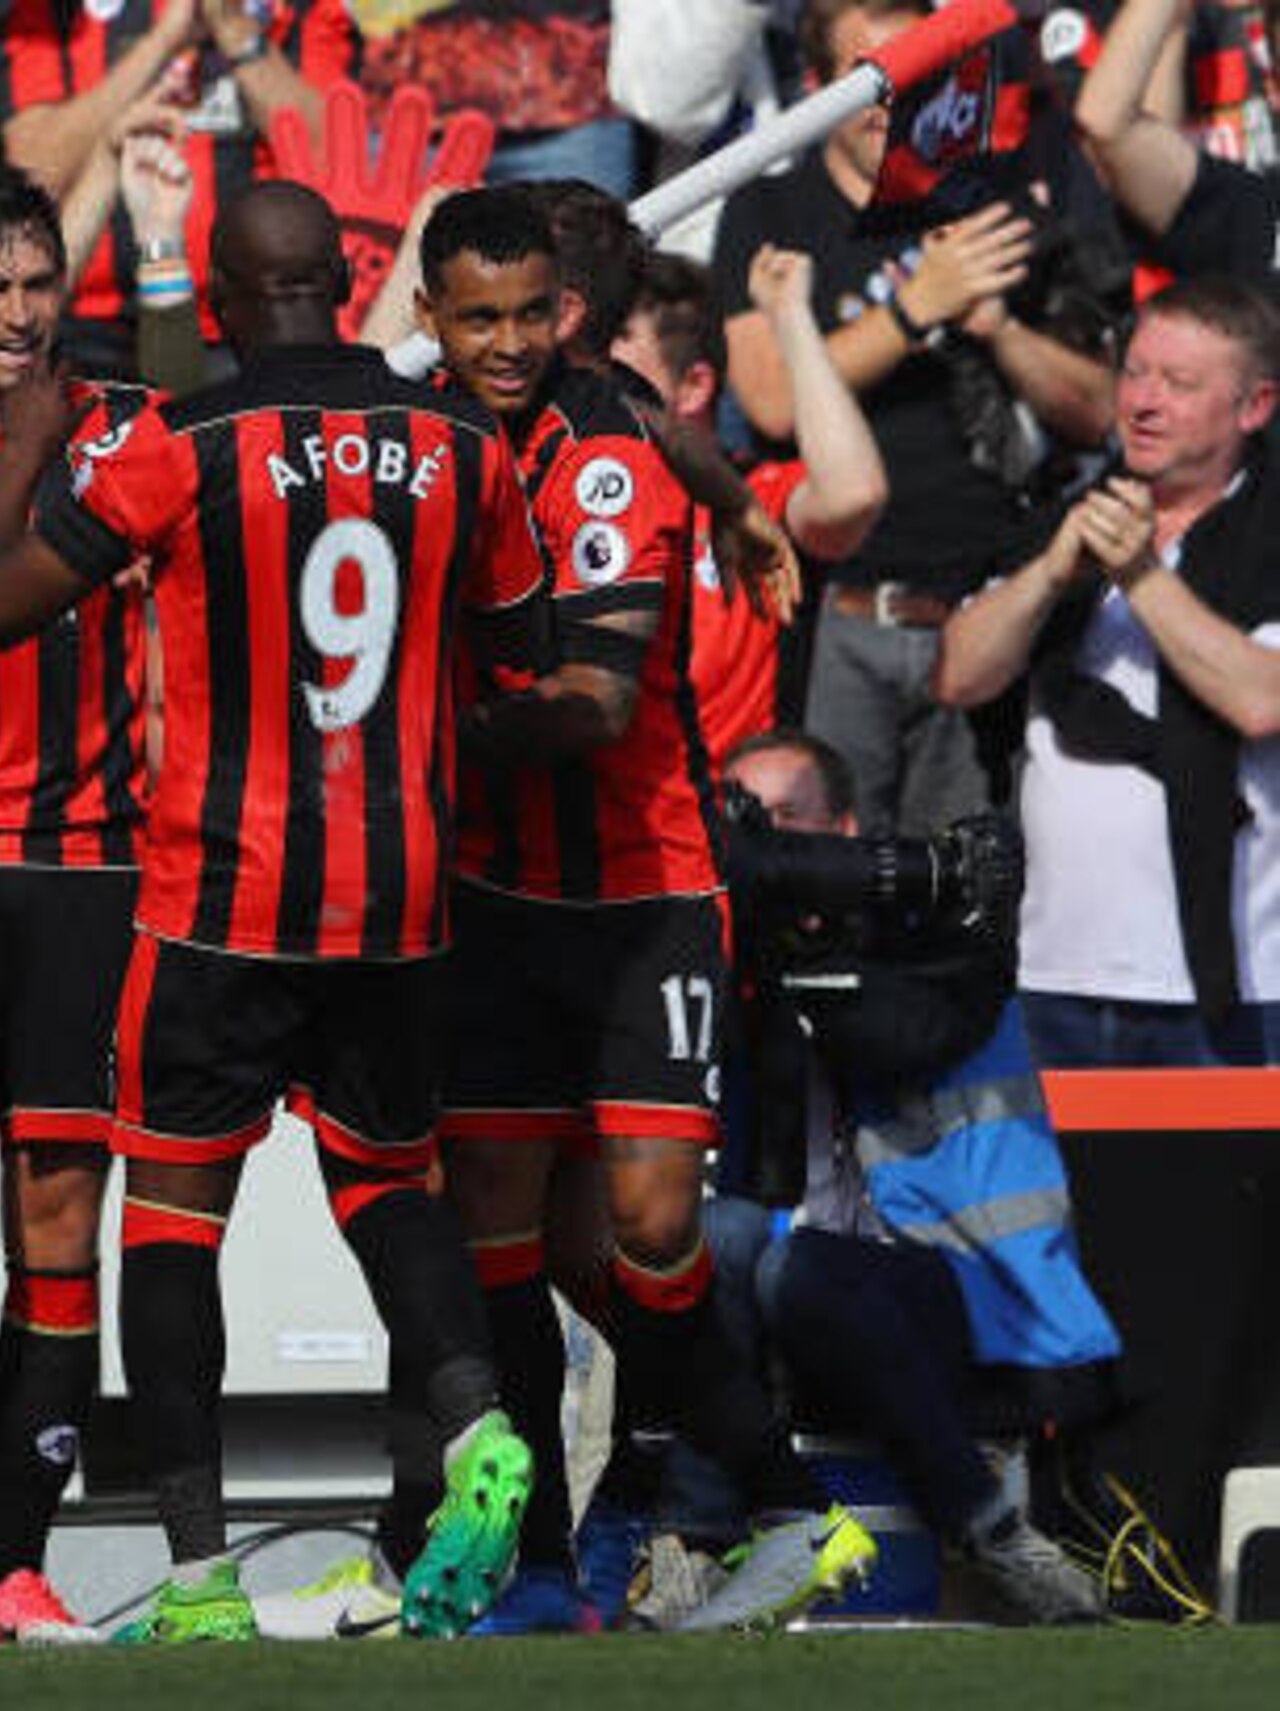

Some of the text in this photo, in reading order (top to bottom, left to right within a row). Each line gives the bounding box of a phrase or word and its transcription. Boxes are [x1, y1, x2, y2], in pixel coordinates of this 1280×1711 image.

[267, 434, 448, 499] AFOBÉ
[299, 516, 398, 732] 9
[660, 976, 713, 1062] 17
